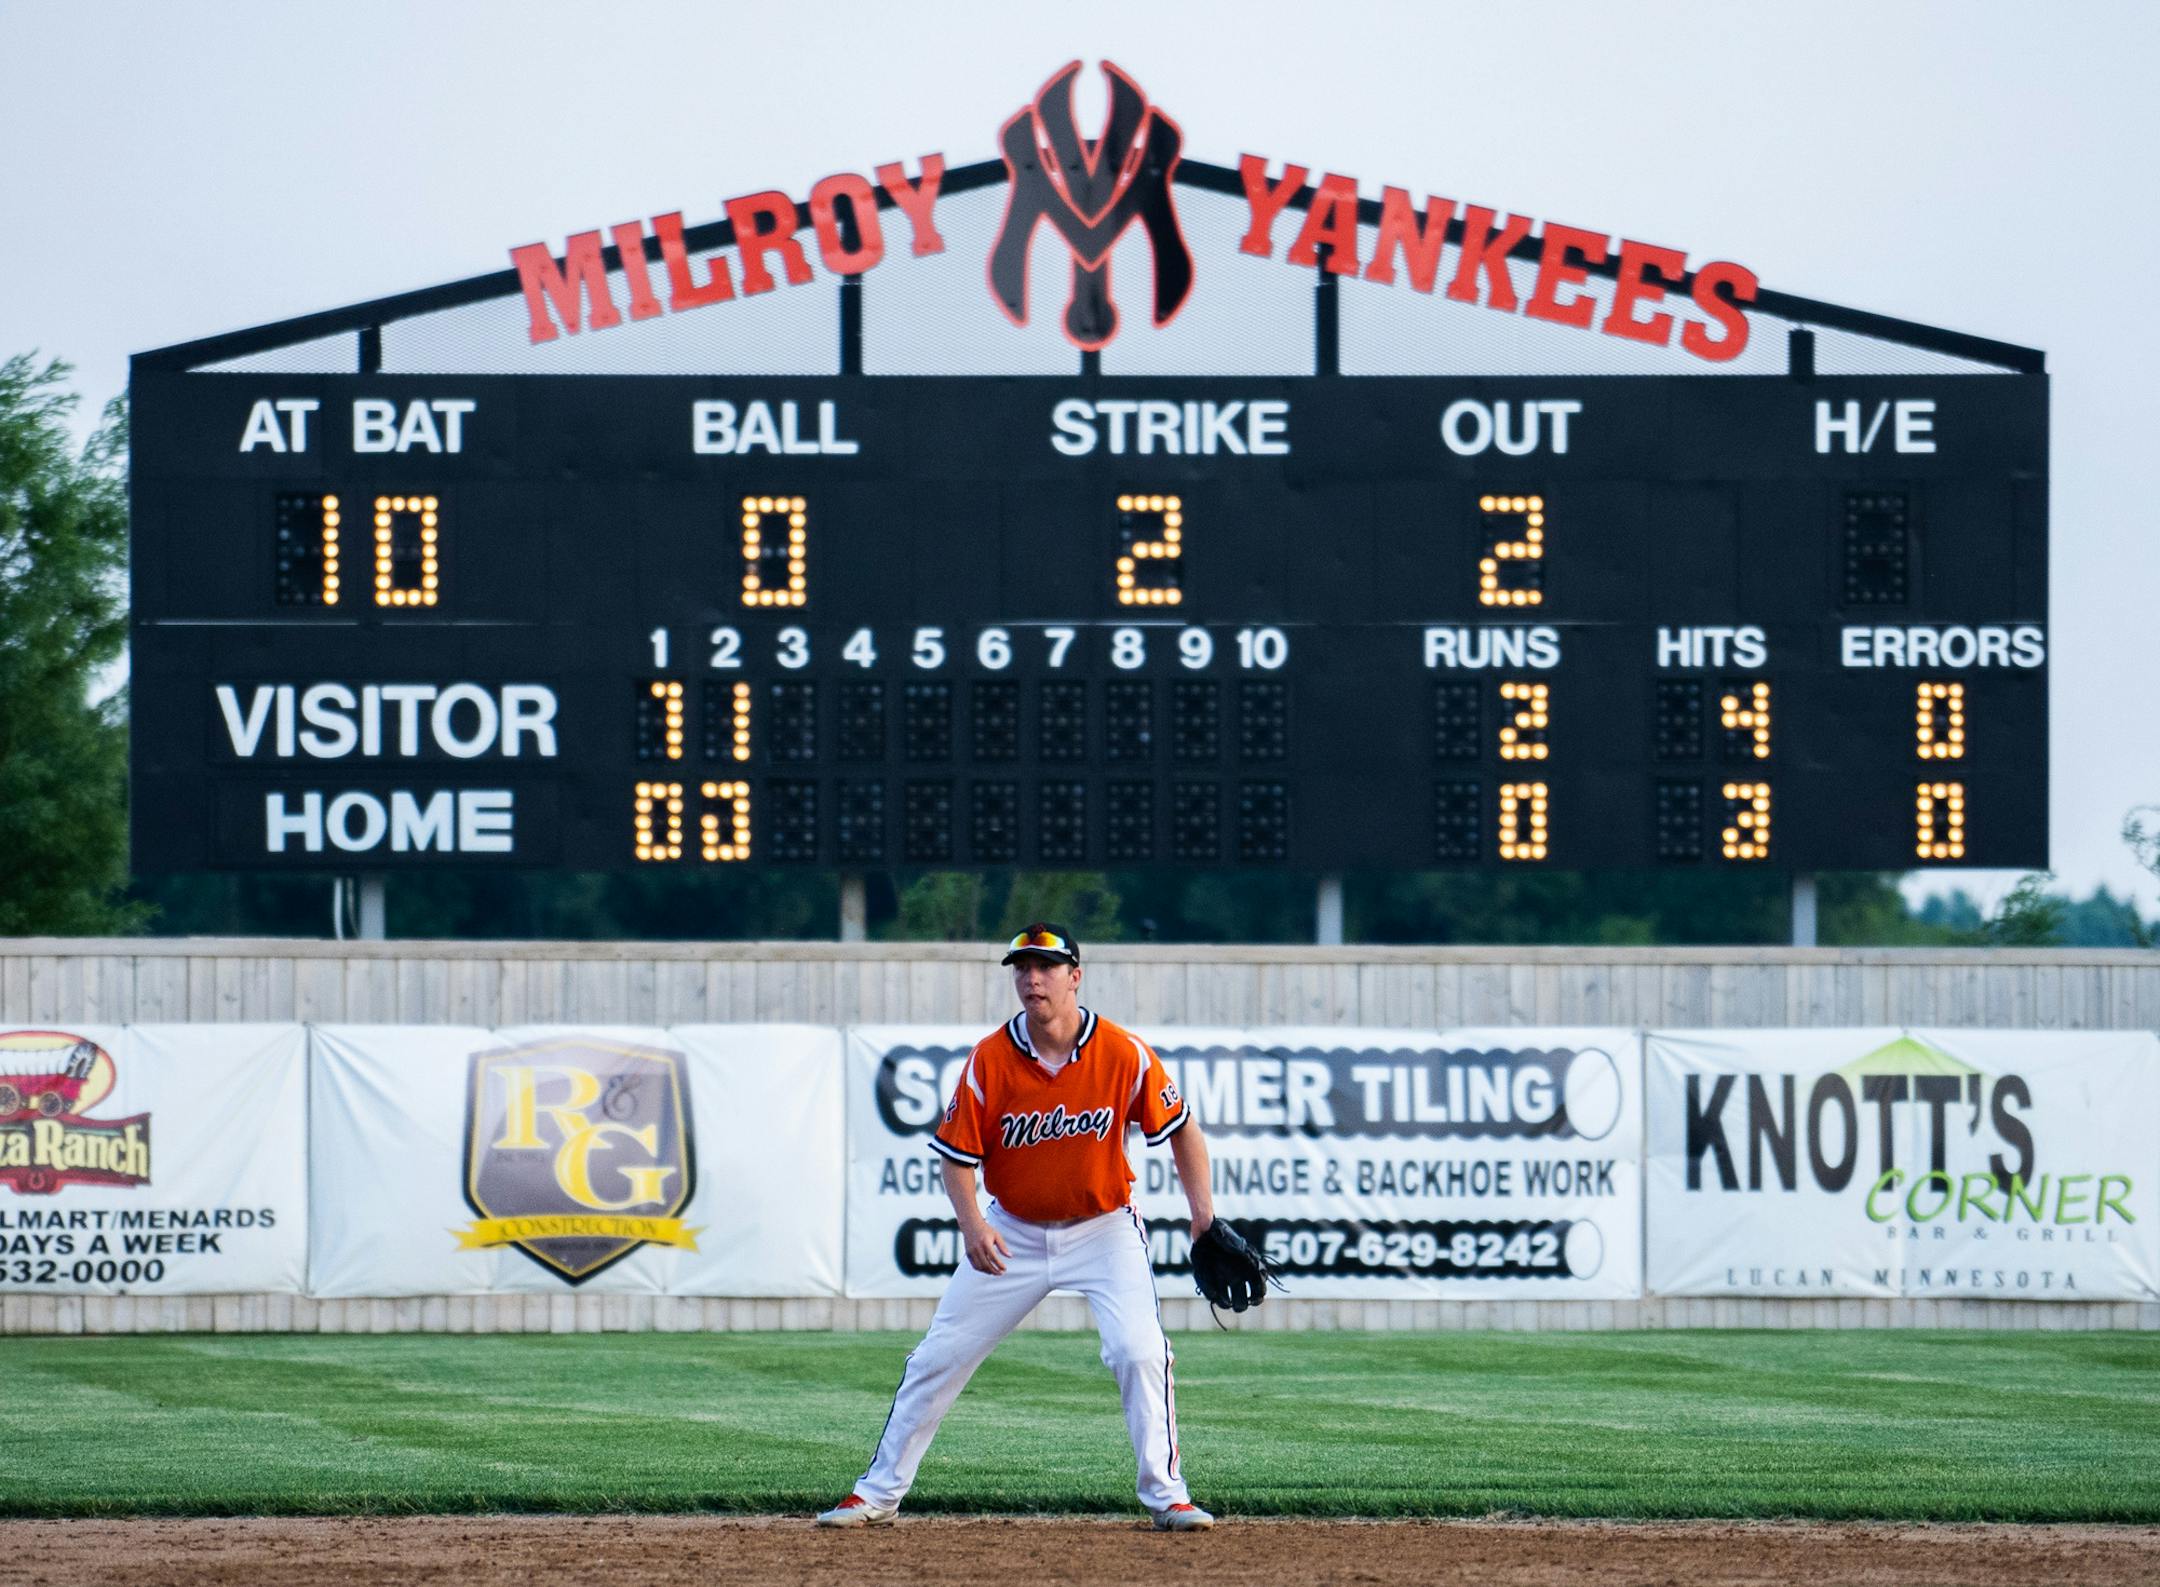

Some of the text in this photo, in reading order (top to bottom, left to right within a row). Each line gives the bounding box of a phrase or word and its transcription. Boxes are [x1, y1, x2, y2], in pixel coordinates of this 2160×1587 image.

[510, 153, 1759, 362] MILROY YANKEES
[239, 400, 1937, 456] AT BAT BALL STRIKE OUT H/E
[322, 495, 1544, 607] 10 0 2 2
[649, 628, 2045, 670] 1 2 3 4 5 6 7 8 9 10 RUNS HITS ERRORS
[217, 682, 558, 759] VISITOR
[732, 681, 751, 761] 1
[1500, 682, 1549, 760] 2
[1720, 682, 1770, 759] 4
[1916, 682, 1964, 760] 0
[266, 792, 514, 853] HOME
[634, 781, 684, 861] 0
[1499, 782, 1549, 859] 0
[1916, 782, 1964, 859] 0
[1160, 1085, 1179, 1109] 18
[1352, 1064, 1556, 1125] TILING
[33, 1118, 149, 1178] Ranch
[1001, 1104, 1114, 1148] Milroy
[1685, 1073, 2035, 1194] KNOTT'S
[1323, 1160, 1343, 1195] &
[1358, 1160, 1512, 1197] BACKHOE
[1525, 1160, 1617, 1197] WORK
[1866, 1169, 2137, 1225] CORNER
[88, 1234, 110, 1254] A
[124, 1232, 223, 1254] WEEK
[501, 1217, 657, 1237] CONSTRUCTION
[1265, 1231, 1558, 1268] 507-629-8242
[1887, 1226, 2119, 1243] BAR & GRILL
[1874, 1268, 2078, 1291] MINNESOTA
